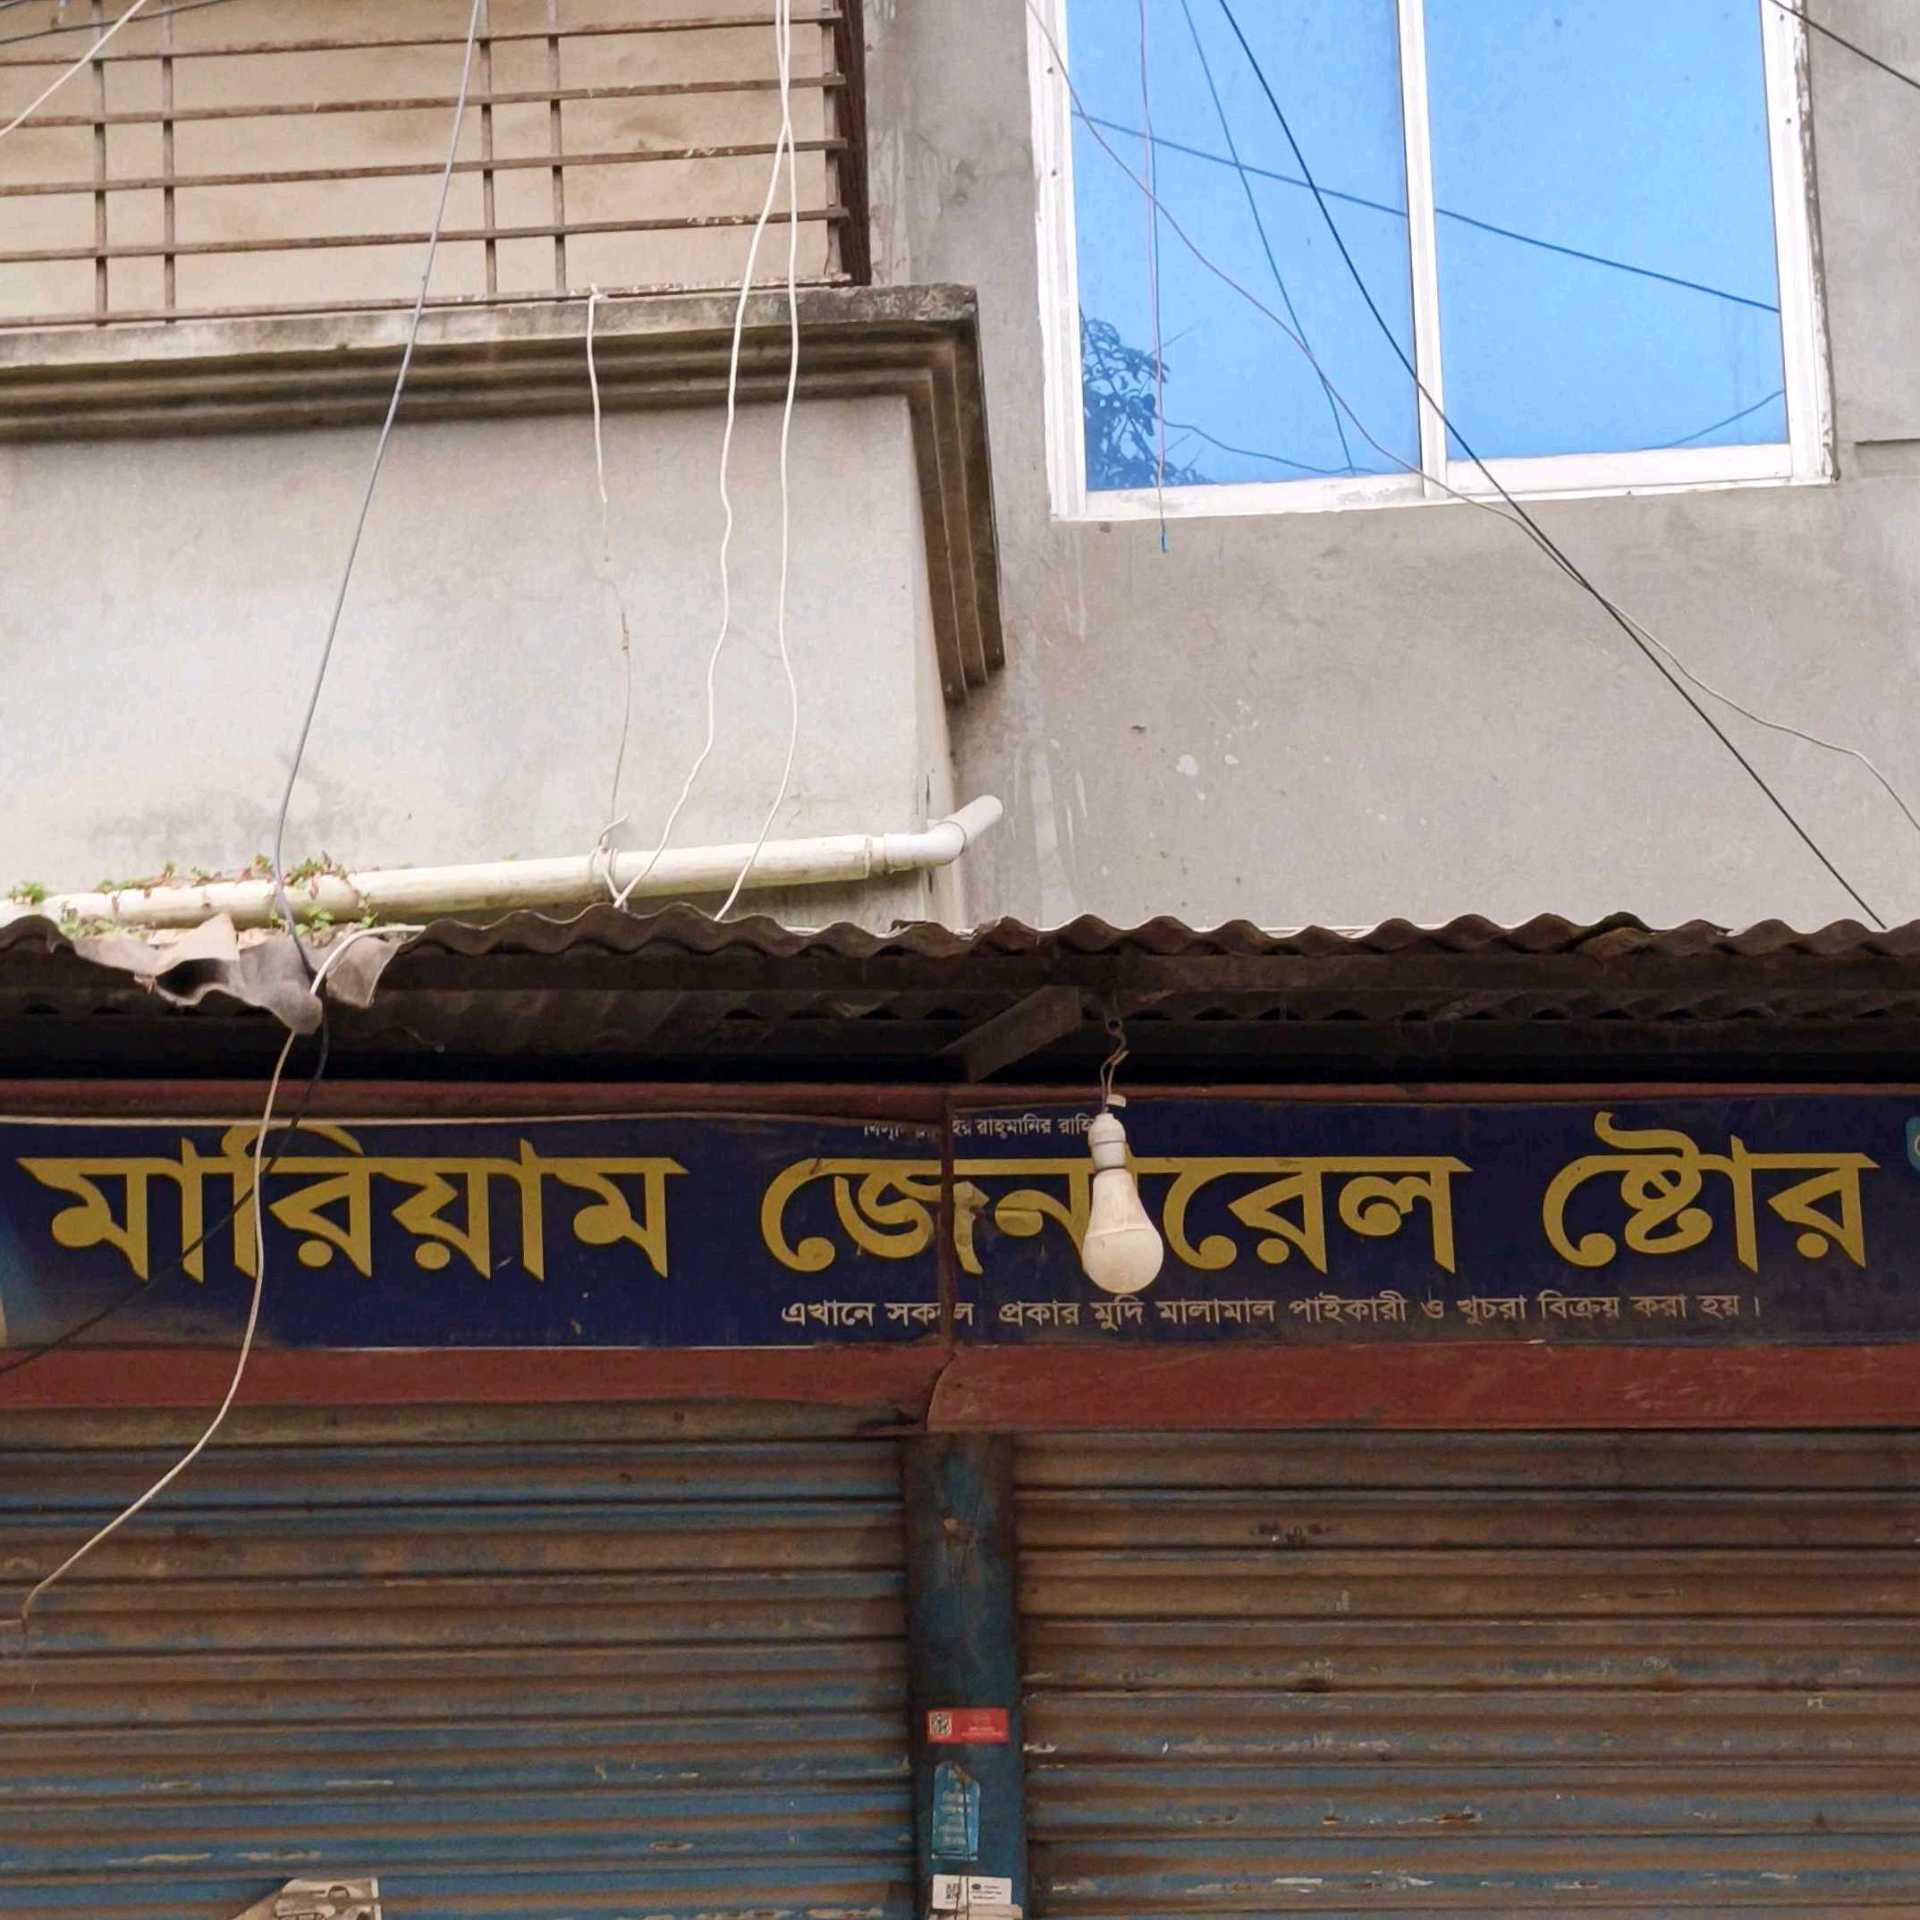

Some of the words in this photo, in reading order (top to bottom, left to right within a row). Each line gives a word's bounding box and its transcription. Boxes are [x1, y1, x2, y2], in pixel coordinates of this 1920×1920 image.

[16, 1124, 690, 1283] মারিয়াম
[761, 1140, 1474, 1275] জেনরেল
[781, 1299, 876, 1328] এখানে
[998, 1299, 1080, 1327] প্রকার
[1090, 1294, 1145, 1332] মুদি
[1156, 1298, 1276, 1325] মালামাল
[1288, 1290, 1408, 1323] পাইকারী
[1420, 1298, 1445, 1320] ও
[1457, 1295, 1528, 1327] খুচরা
[1537, 1289, 1621, 1320] বিক্রয়
[1629, 1293, 1688, 1319] করা
[1696, 1294, 1740, 1320] হয়
